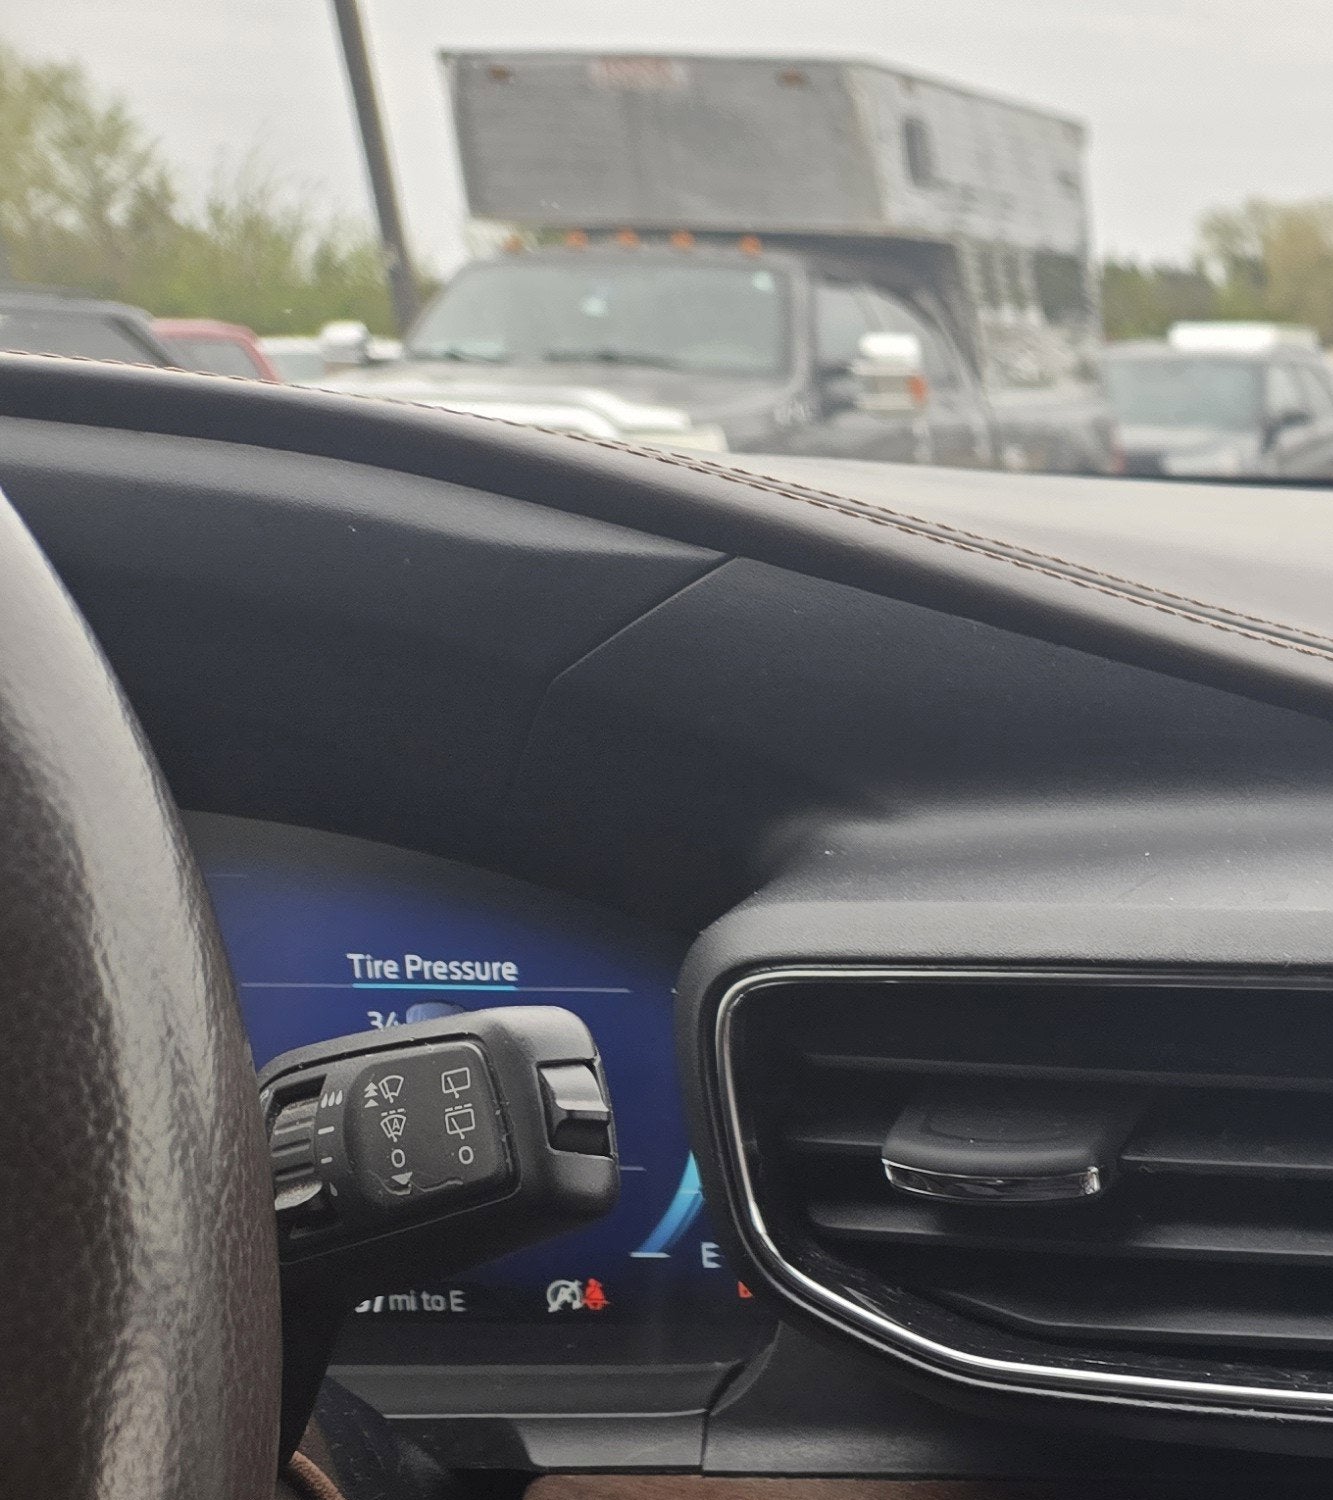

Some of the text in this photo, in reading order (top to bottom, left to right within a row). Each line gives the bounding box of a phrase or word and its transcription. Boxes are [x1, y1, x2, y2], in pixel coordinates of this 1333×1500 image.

[346, 952, 519, 982] Tire Pressure
[701, 1241, 722, 1269] E
[388, 1289, 418, 1312] mi
[420, 1290, 447, 1312] to
[449, 1289, 468, 1312] E
